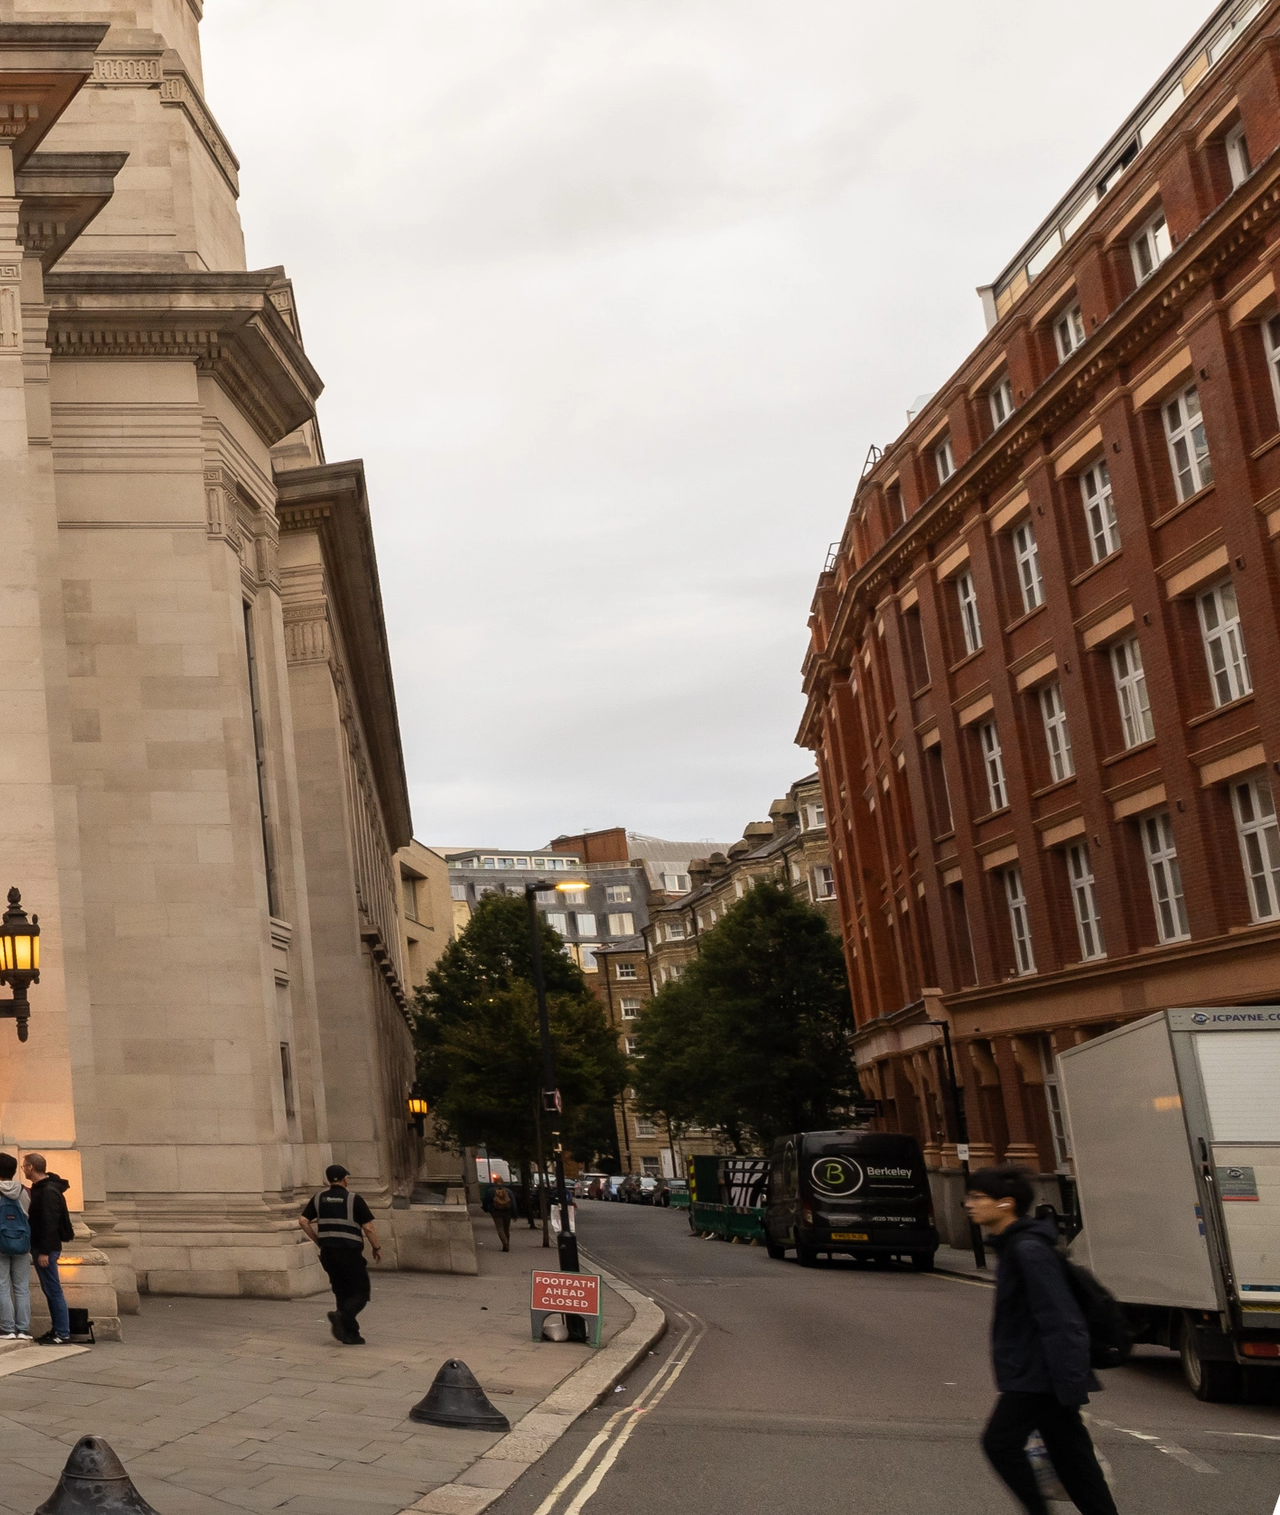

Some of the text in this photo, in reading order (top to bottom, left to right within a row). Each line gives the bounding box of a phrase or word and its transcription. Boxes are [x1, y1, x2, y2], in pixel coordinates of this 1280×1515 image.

[867, 1166, 912, 1179] Berkeley
[536, 1276, 595, 1288] FOOTPATH
[545, 1287, 585, 1297] AHEAD
[541, 1296, 588, 1308] CLOSED
